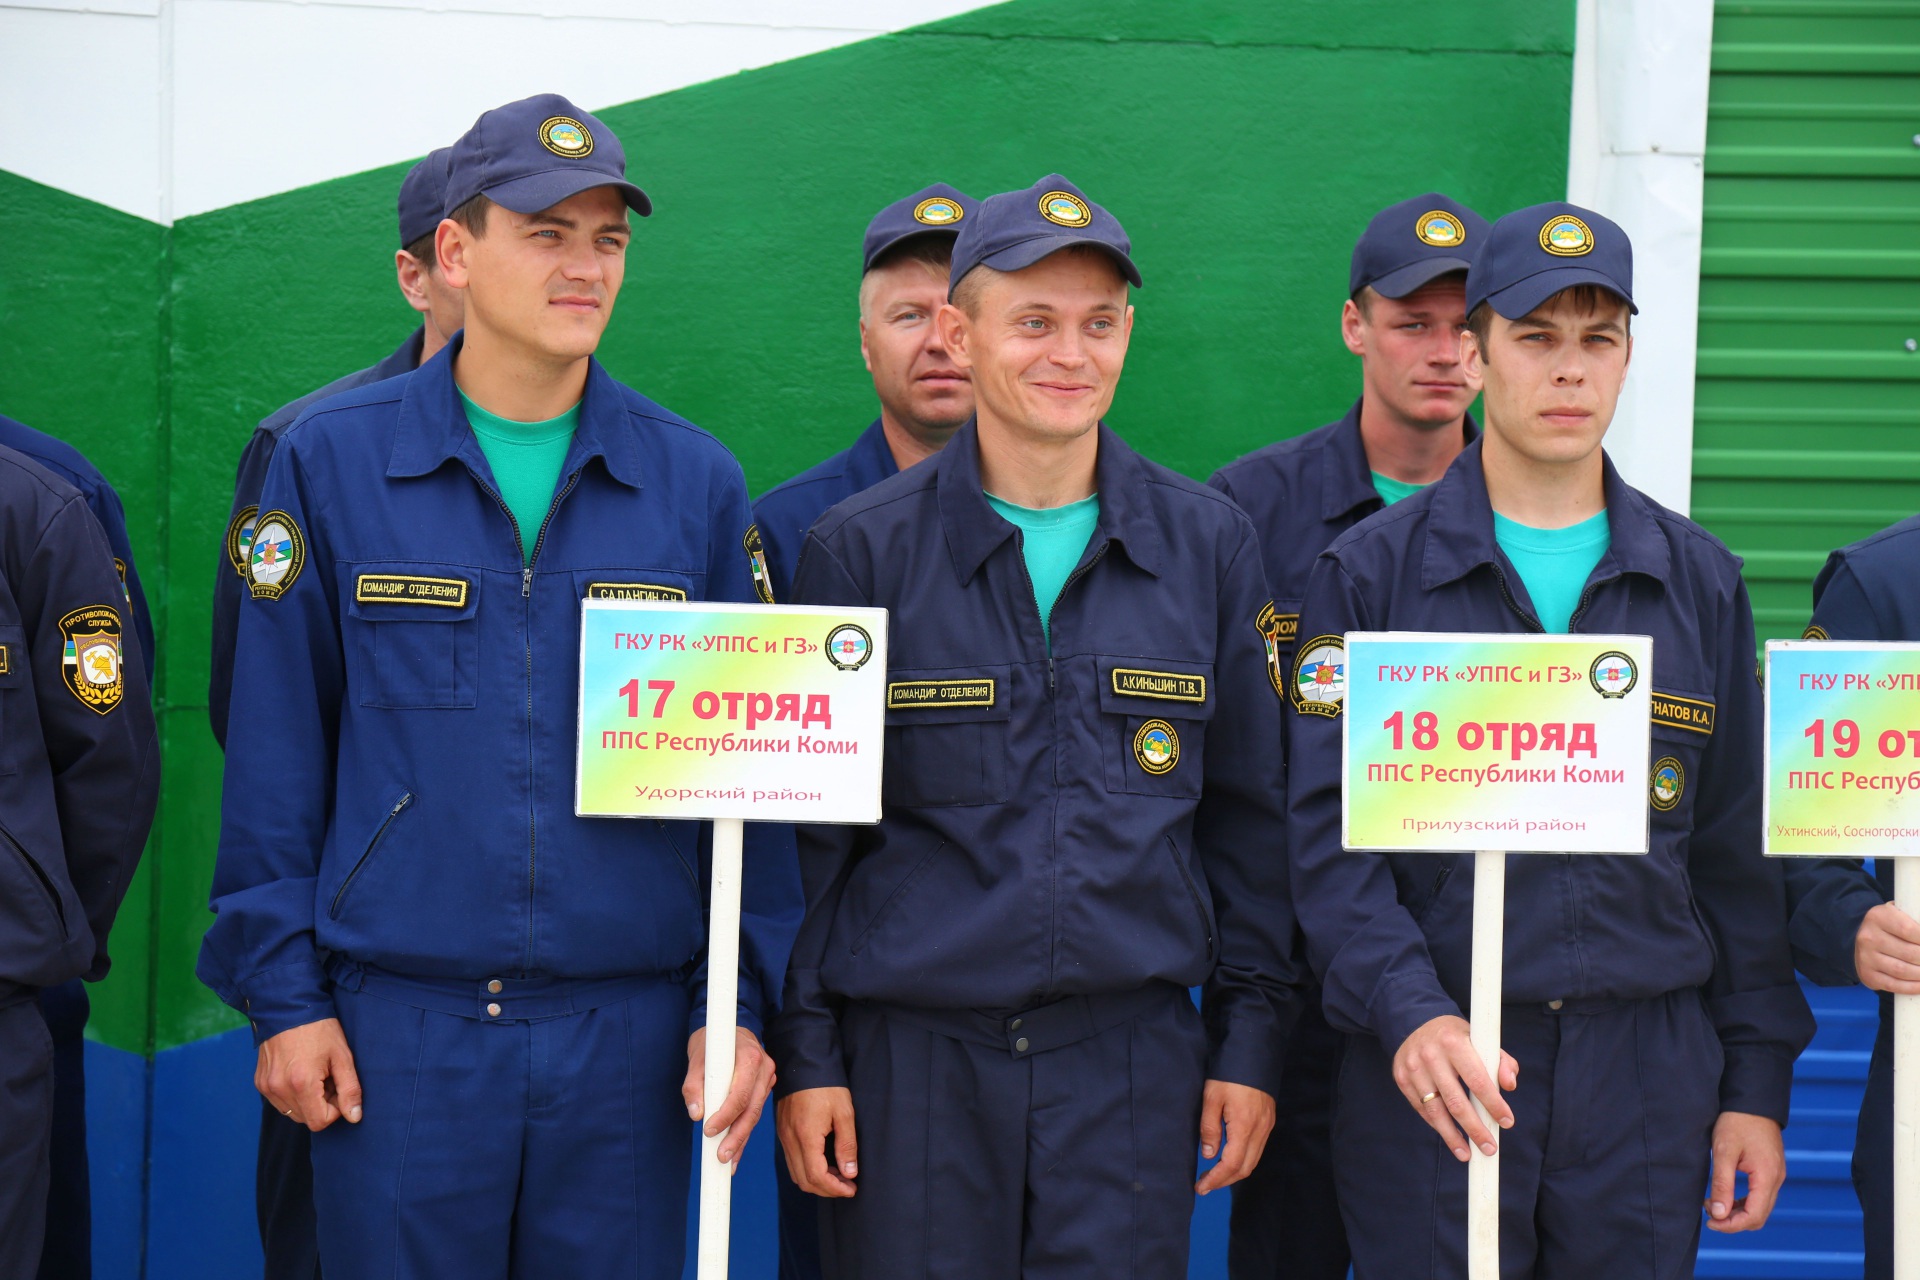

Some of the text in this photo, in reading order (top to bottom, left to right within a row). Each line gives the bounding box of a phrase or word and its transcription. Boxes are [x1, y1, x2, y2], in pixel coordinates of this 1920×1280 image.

[362, 582, 459, 597] КОМАНДИР ОТДЕЛЕНИЯ
[614, 633, 653, 650] ГКУ
[659, 634, 686, 651] РК
[692, 635, 759, 654] «УППС
[765, 640, 777, 653] и
[783, 637, 818, 655] ГЗ»
[1377, 665, 1417, 683] ГКУ
[1423, 665, 1449, 683] РК
[1455, 666, 1523, 683] «УППС
[1529, 670, 1541, 683] и
[1547, 666, 1582, 683] ГЗ»
[1799, 674, 1920, 690] ГКУ РК «УП
[894, 686, 988, 700] КОМАНДИР ОТДЕЛЕНИЯ
[1122, 675, 1199, 695] АКИНЬШИН П.В.
[618, 679, 831, 730] 17 отряд
[1651, 700, 1710, 725] НАТОВ К.А.
[602, 731, 858, 757] ППС Республики Коми
[1383, 711, 1597, 760] 18 отряд
[1804, 719, 1860, 758] 19
[1368, 764, 1625, 788] ППС Республики Коми
[1789, 771, 1835, 790] ППС
[635, 785, 822, 803] Удорский район
[1402, 818, 1586, 834] Прилузский район
[1776, 825, 1841, 839] Ухтинский,
